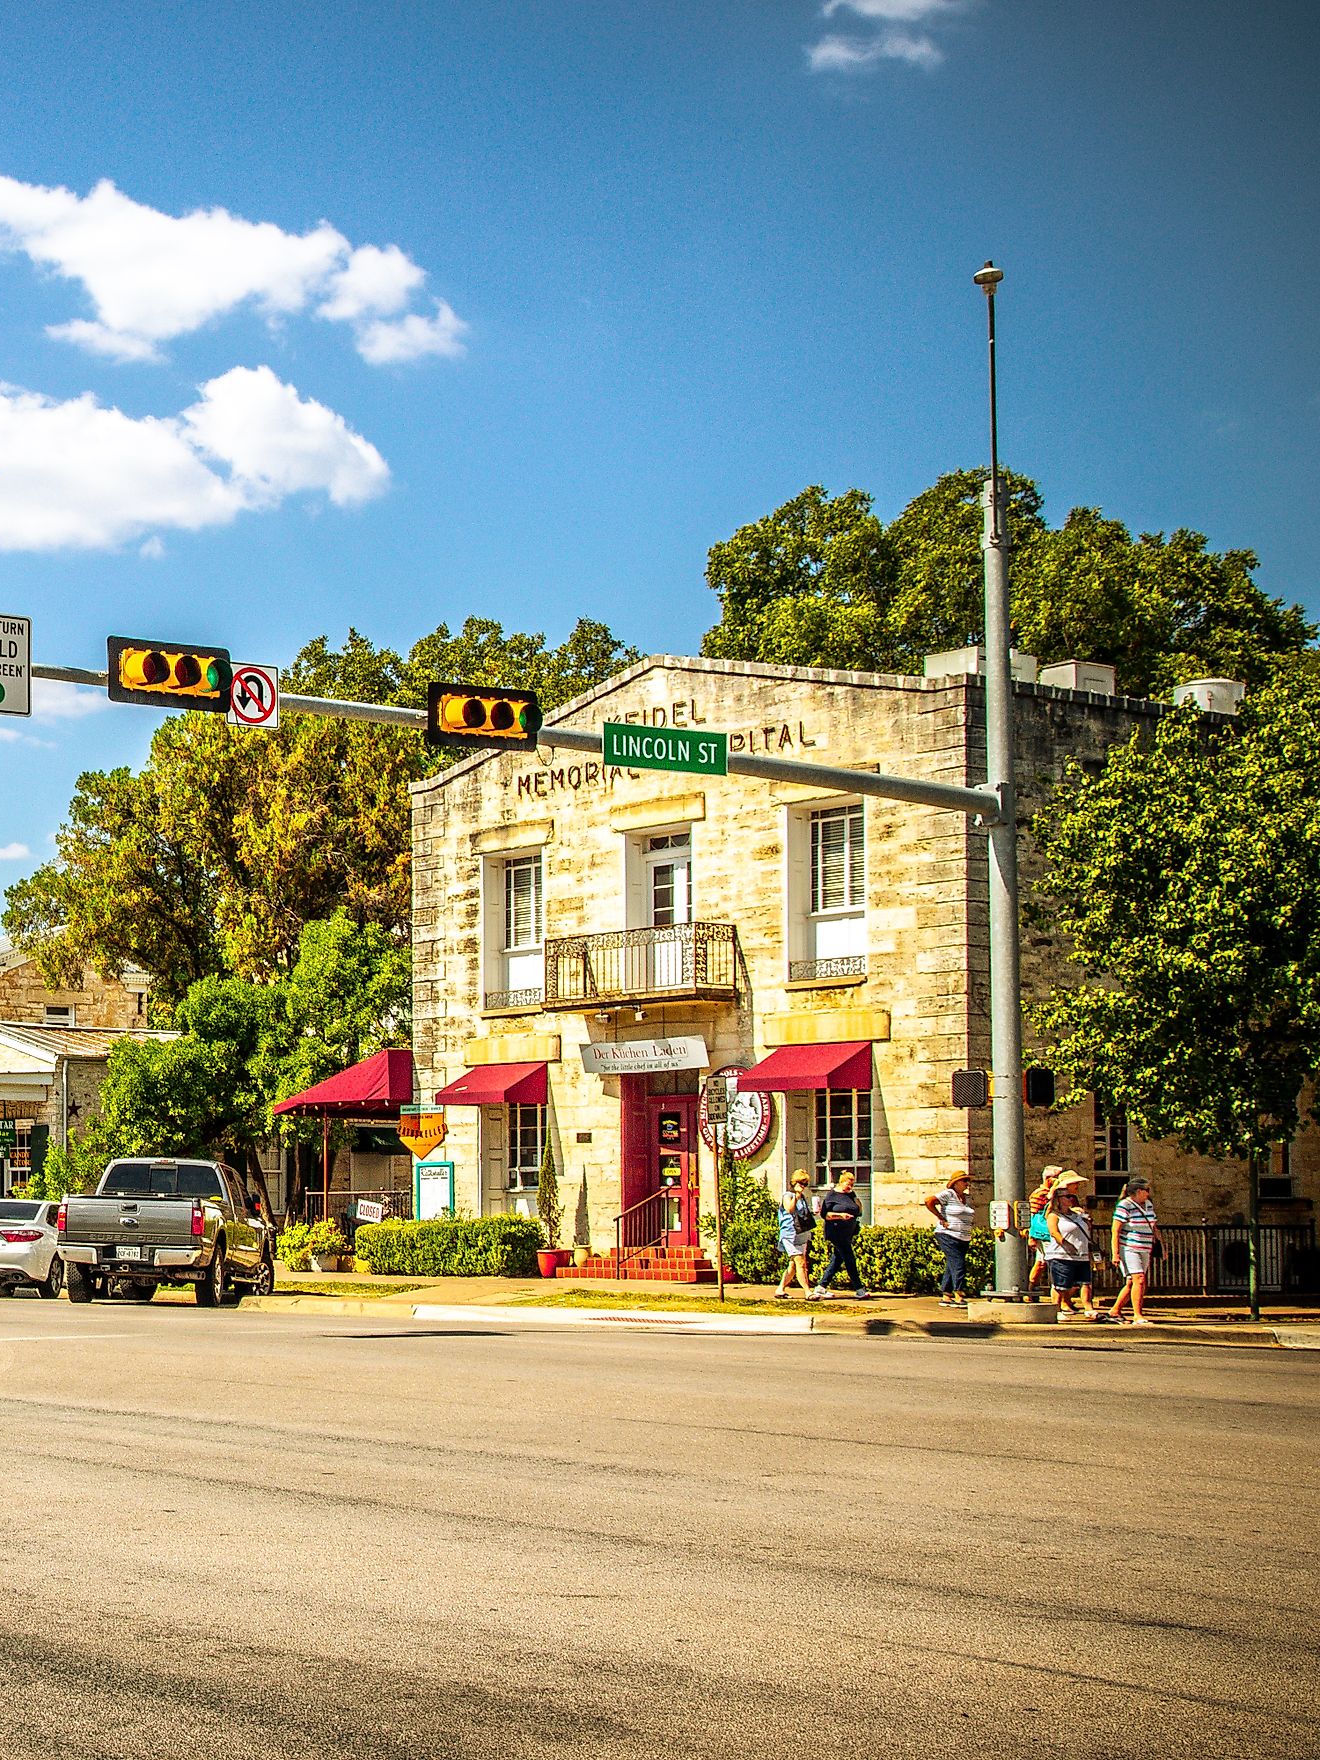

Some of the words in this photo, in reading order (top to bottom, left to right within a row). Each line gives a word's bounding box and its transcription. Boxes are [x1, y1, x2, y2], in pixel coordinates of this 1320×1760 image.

[730, 721, 815, 752] PITAL
[612, 734, 690, 762] LINCOLN
[698, 742, 718, 764] ST
[593, 1048, 609, 1060] Der
[652, 1043, 687, 1056] Laden
[611, 1063, 619, 1071] the
[359, 1203, 380, 1218] CLOSED
